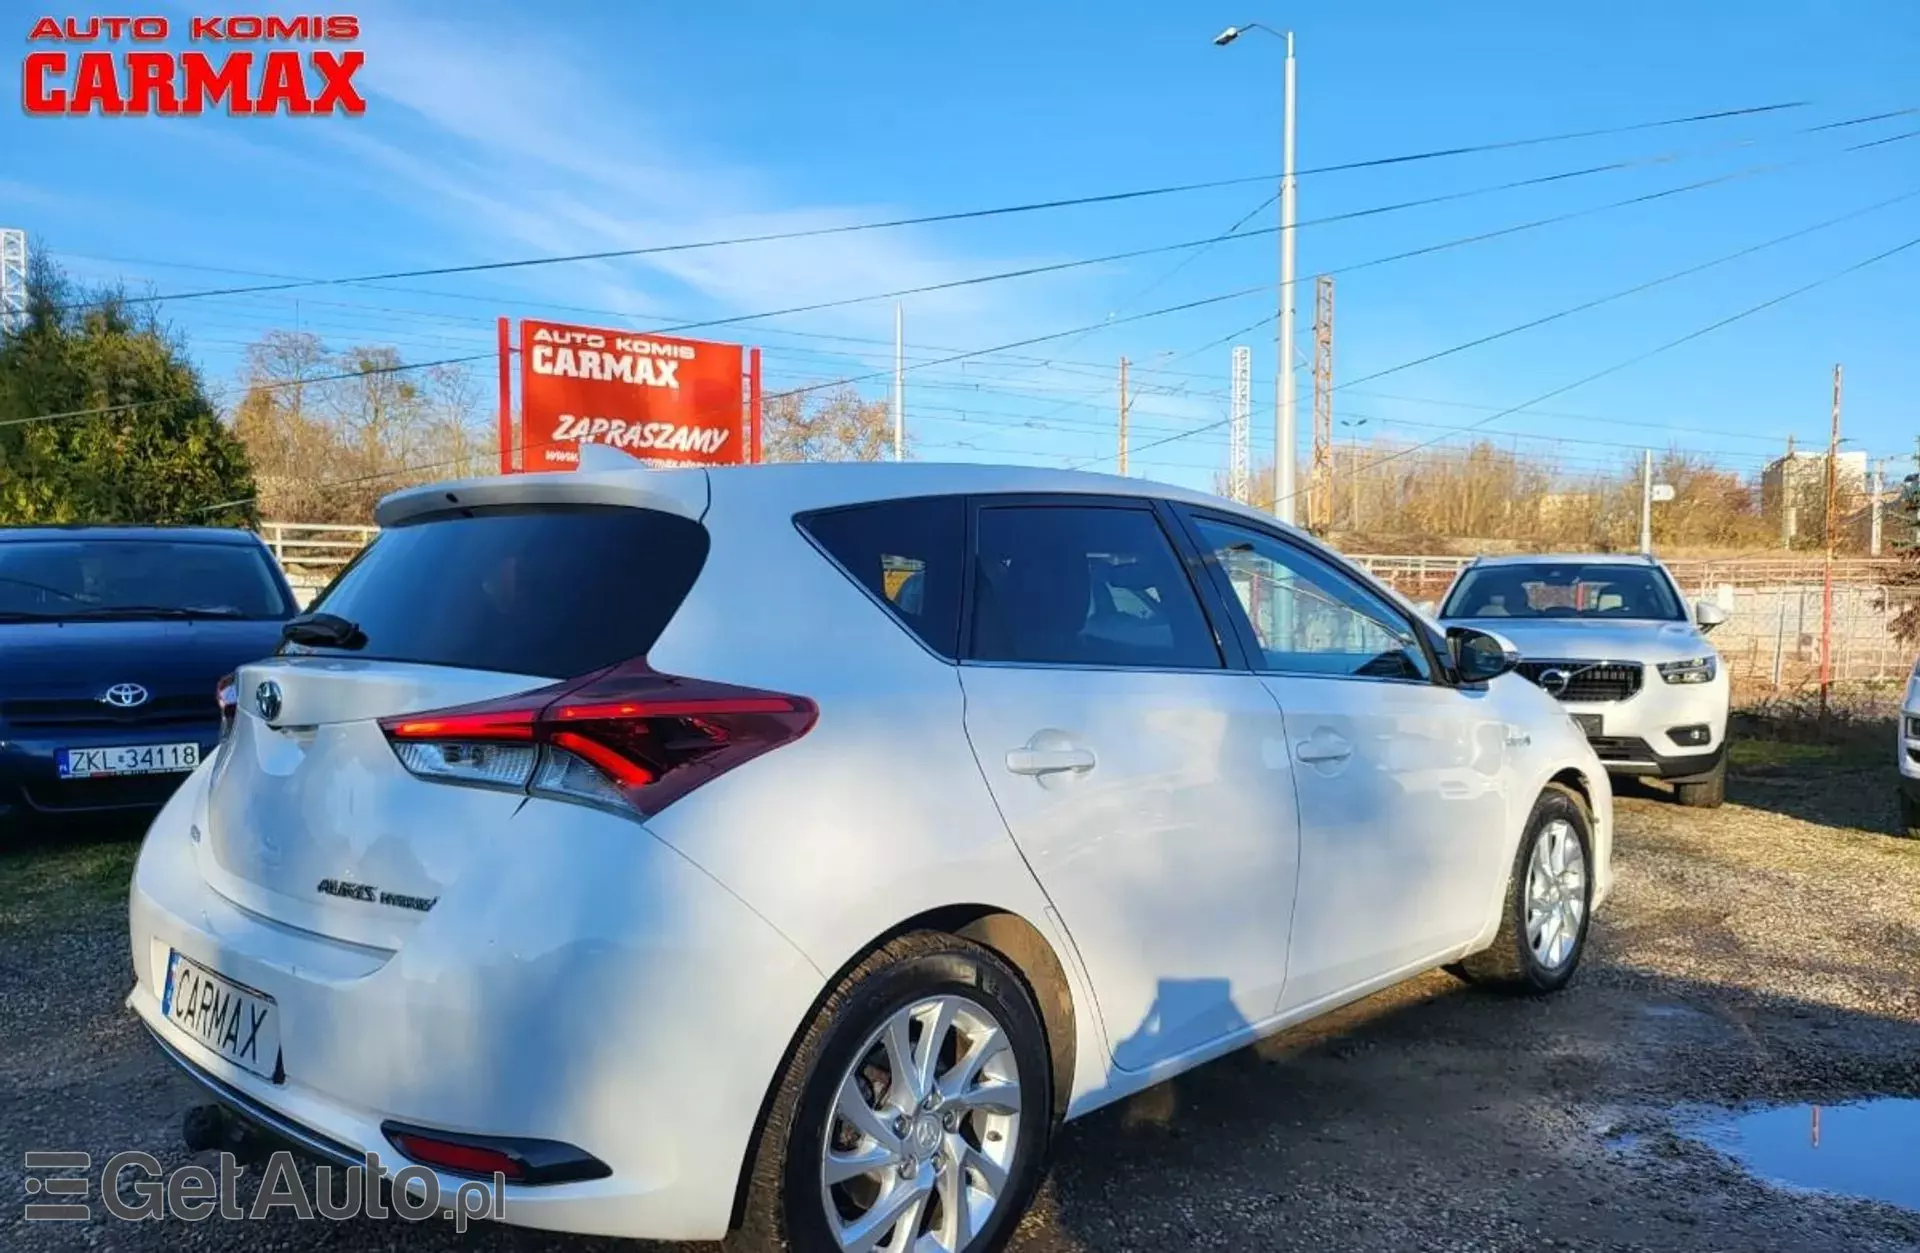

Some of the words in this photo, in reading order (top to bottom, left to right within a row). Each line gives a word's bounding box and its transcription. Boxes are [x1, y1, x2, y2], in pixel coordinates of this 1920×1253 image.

[533, 327, 606, 349] AUTO
[616, 337, 696, 360] KOMIS
[532, 344, 680, 390] CARMAX
[551, 413, 730, 454] ZAPRASZAMY
[71, 749, 117, 773] ZKL
[126, 745, 197, 769] 34118
[175, 967, 269, 1065] CARMAX
